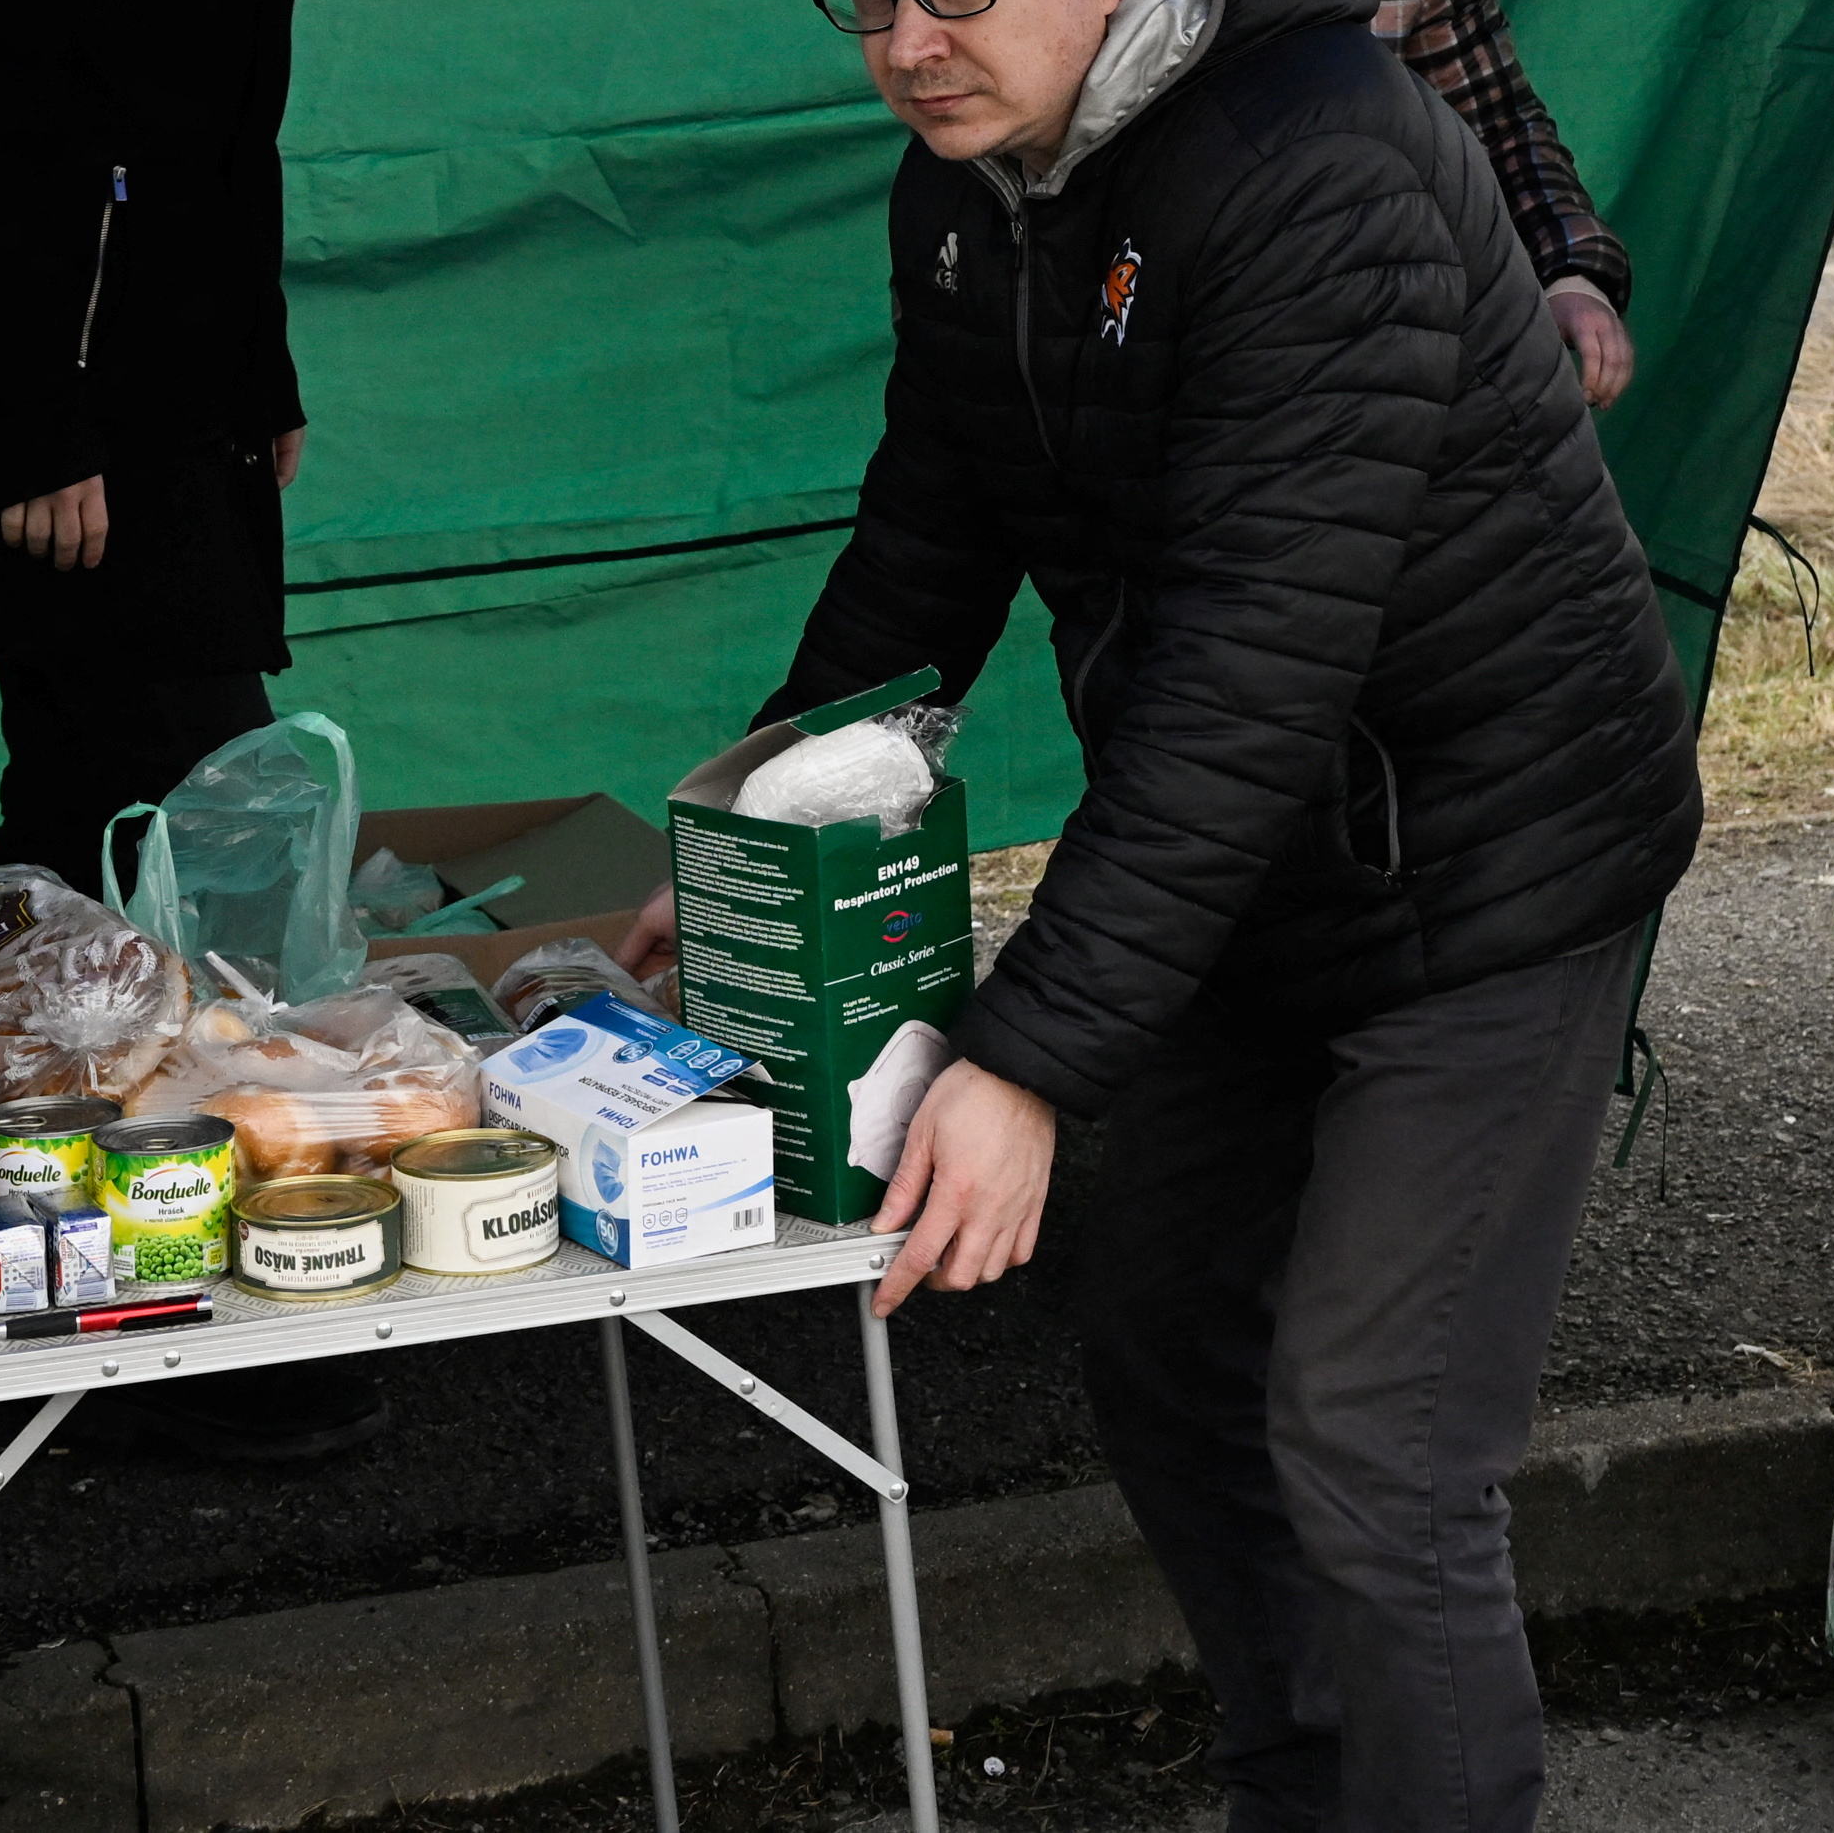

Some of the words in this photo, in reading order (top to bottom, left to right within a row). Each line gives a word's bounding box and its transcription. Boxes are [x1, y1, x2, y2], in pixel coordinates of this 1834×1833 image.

[877, 855, 920, 882] EN149
[834, 882, 903, 911] Respiratory
[904, 862, 958, 889] Protection
[870, 955, 907, 977] Classic
[907, 944, 936, 964] Series
[489, 1081, 522, 1112] FOHWA
[596, 1106, 640, 1129] FOHWA
[641, 1145, 700, 1169] FOHWA
[131, 1177, 211, 1205] Bonduelle
[158, 1207, 185, 1216] Hrášek
[600, 1219, 616, 1241] 50
[254, 1245, 296, 1273] MÄSO
[301, 1243, 366, 1274] TRHANÉ
